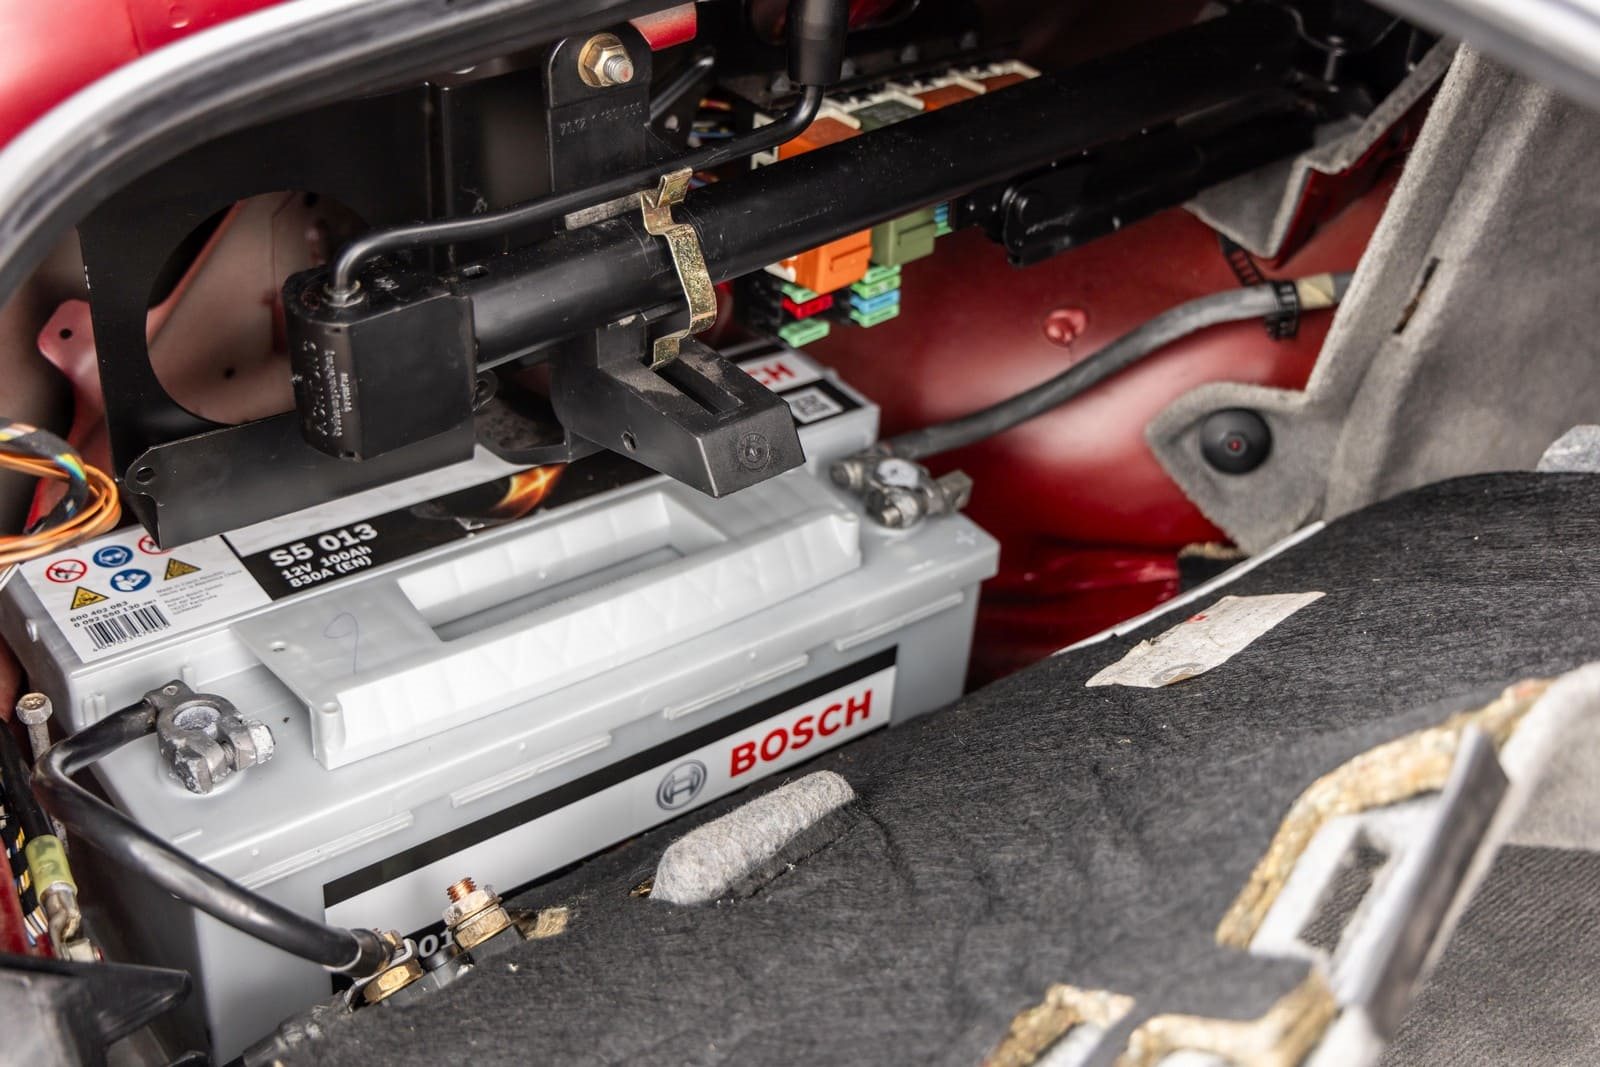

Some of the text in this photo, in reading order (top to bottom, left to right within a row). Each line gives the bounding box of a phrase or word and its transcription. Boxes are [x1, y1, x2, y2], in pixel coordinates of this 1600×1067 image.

[269, 523, 378, 567] S5 013
[281, 545, 372, 580] 12V 100Ah
[289, 555, 372, 588] 830A (EN)
[730, 689, 873, 778] BOSCH
